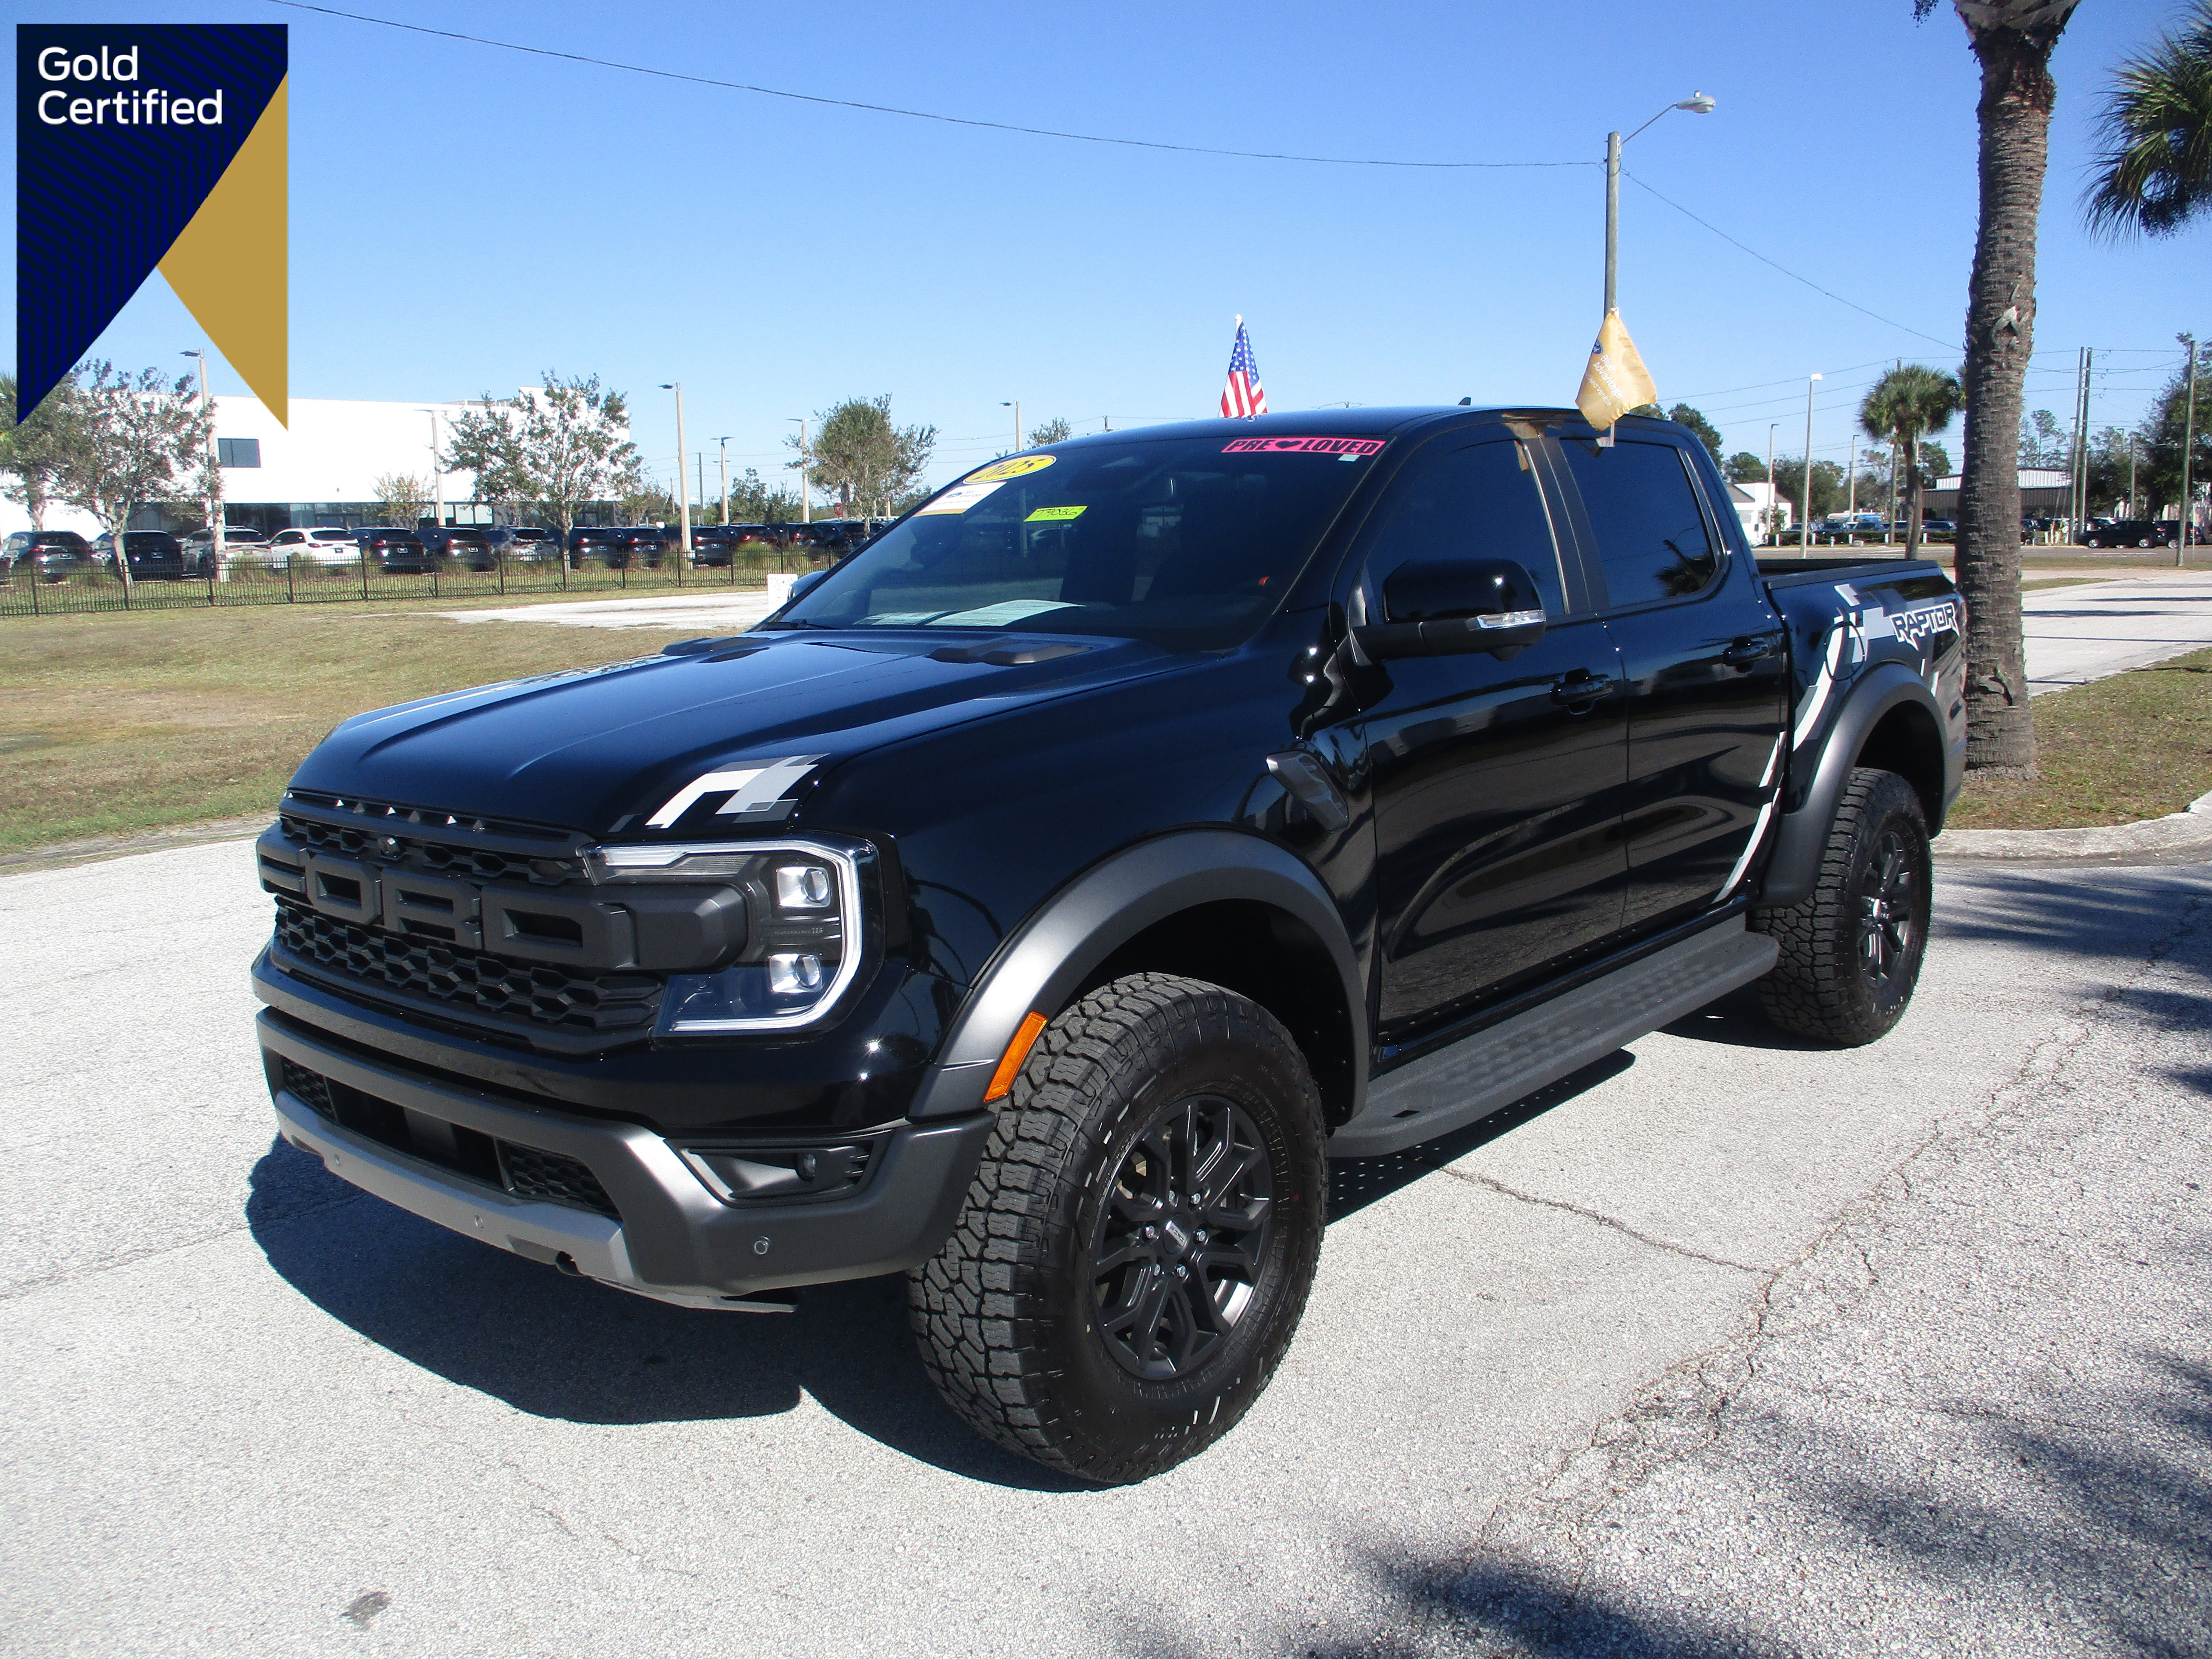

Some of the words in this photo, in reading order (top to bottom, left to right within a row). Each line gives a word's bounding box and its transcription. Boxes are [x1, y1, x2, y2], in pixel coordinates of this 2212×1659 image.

[1600, 354, 1615, 372] Blue
[1593, 362, 1623, 399] Advantage
[1597, 387, 1611, 406] Vehicle
[1225, 439, 1276, 451] PRE
[1299, 439, 1379, 453] LOVED
[1889, 602, 1960, 652] RAPTOR
[257, 831, 638, 969] FORD
